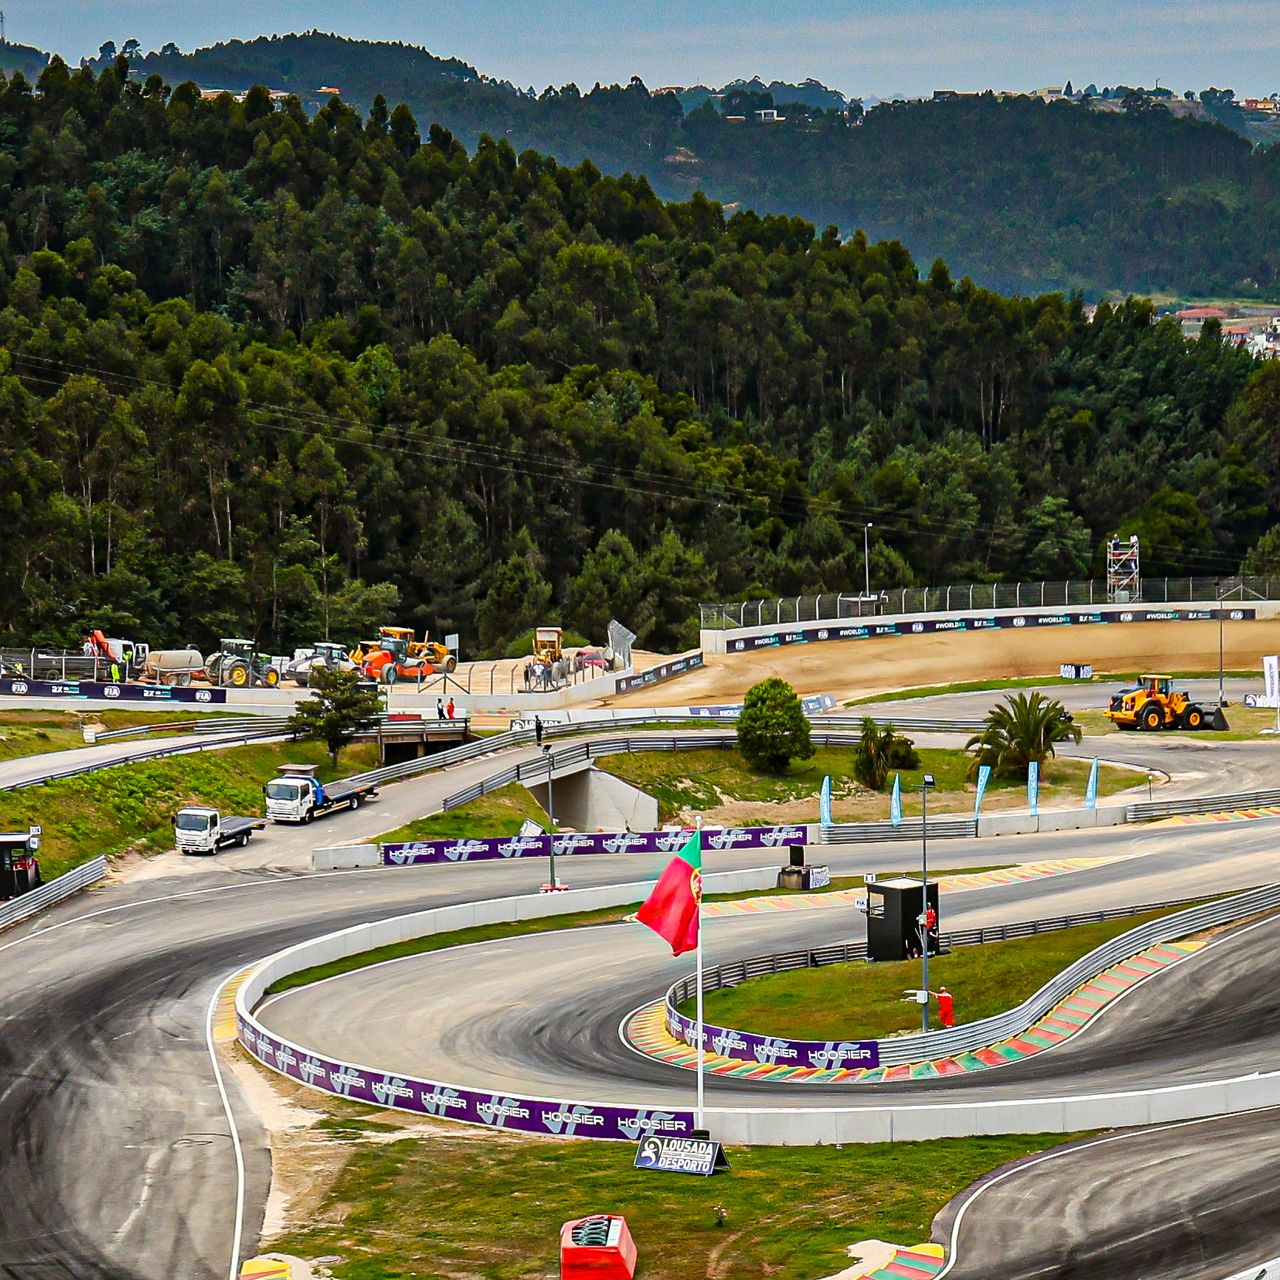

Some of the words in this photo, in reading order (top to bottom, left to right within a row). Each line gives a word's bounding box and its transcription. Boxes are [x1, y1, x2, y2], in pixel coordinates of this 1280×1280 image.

[1038, 616, 1070, 624] #WORLDRX
[389, 847, 435, 858] HOOSIER
[444, 844, 489, 854] HOOSIER
[498, 841, 542, 851] HOOSIER
[552, 839, 594, 849] HOOSIER
[602, 837, 647, 847] HOOSIER
[655, 836, 693, 846] HOOSIE
[708, 833, 752, 843] HOOSIER
[760, 830, 802, 841] HOOSIER
[712, 1035, 747, 1050] HOOSIER
[753, 1043, 797, 1059] HOOSIER
[808, 1050, 871, 1060] HOOSIER
[299, 1061, 326, 1078] HOOSIER
[329, 1071, 366, 1089] HOOSIER
[371, 1081, 414, 1099] HOOSIER
[421, 1091, 467, 1110] HOOSIER
[476, 1101, 529, 1119] HOOSIER
[541, 1110, 604, 1126] HOOSIER
[617, 1116, 686, 1131] HOOSIER
[663, 1138, 713, 1155] LOUSADA
[658, 1157, 710, 1172] DESPORTO
